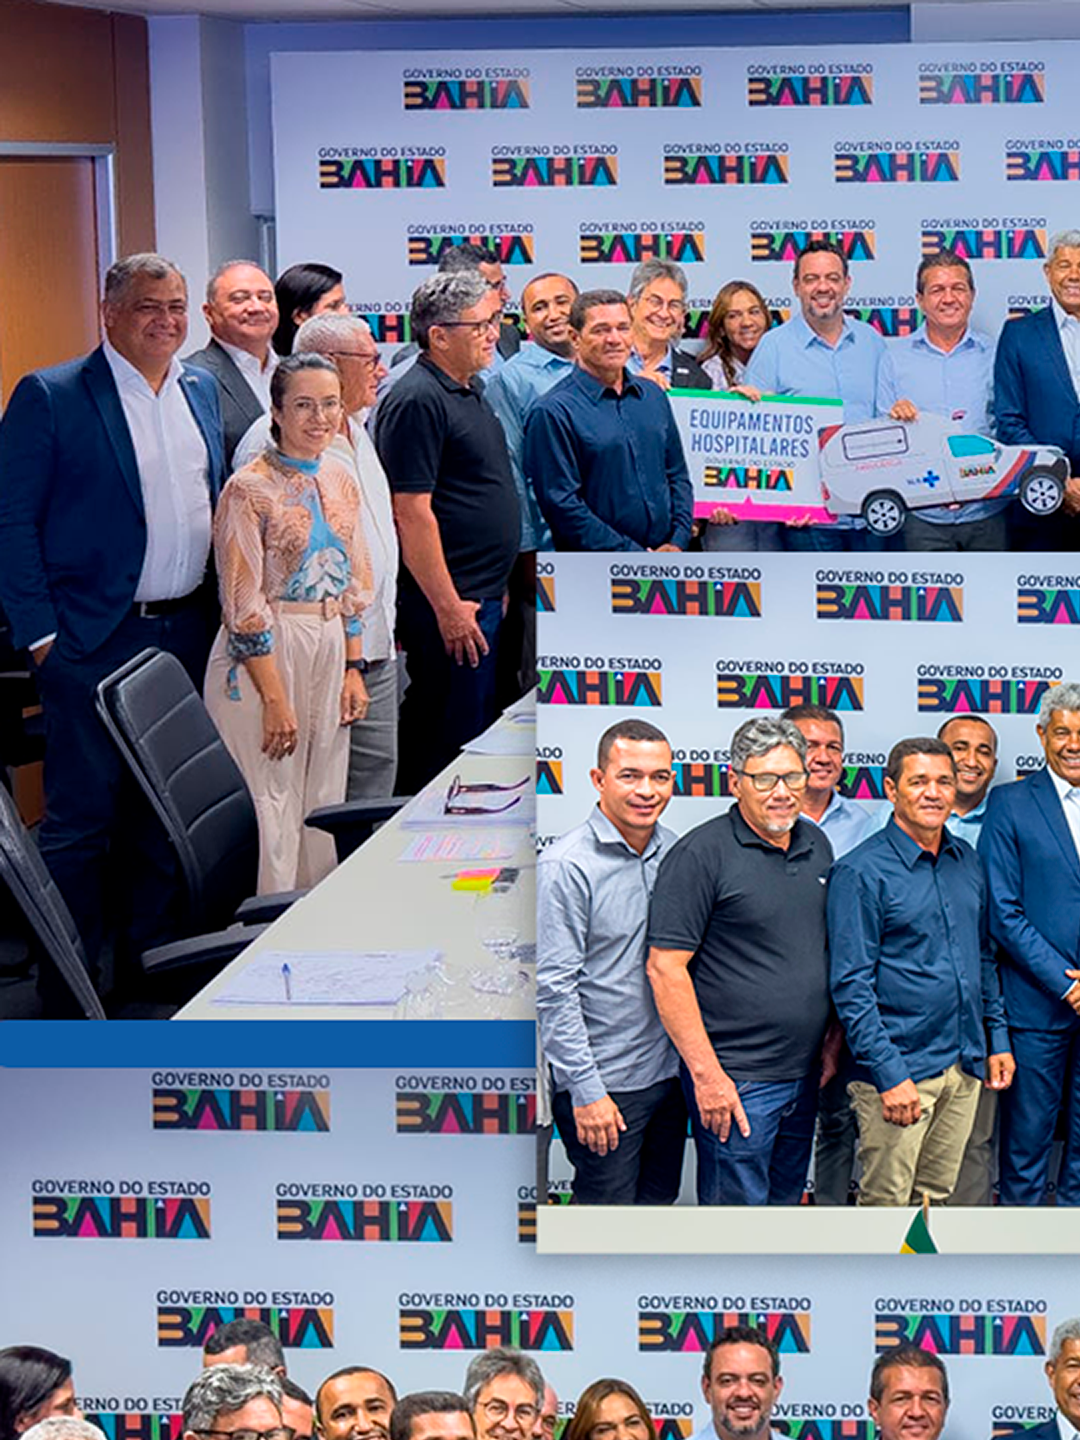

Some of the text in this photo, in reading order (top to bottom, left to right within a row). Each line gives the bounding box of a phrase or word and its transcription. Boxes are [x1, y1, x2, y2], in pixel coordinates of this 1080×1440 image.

[401, 67, 530, 80] GOVERNO DO ESTADO
[917, 60, 1046, 74] GOVERNO DO ESTADO
[490, 143, 619, 157] GOVERNO DO ESTADO
[833, 139, 961, 153] GOVERNO DO ESTADO
[1004, 139, 1065, 152] GOVERNO
[689, 408, 814, 435] EQUIPAMENTOS
[691, 433, 810, 458] HOSPITALARES
[609, 563, 762, 581] GOVERNO DO ESTADO
[815, 569, 965, 586] GOVERNO DO ESTADO
[150, 1070, 331, 1089] GOVERNO DO ESTADO
[31, 1178, 211, 1197] GOVERNO DO ESTADO
[275, 1182, 454, 1200] GOVERNO DO ESTADO
[398, 1292, 575, 1309] GOVERNO DO ESTADO
